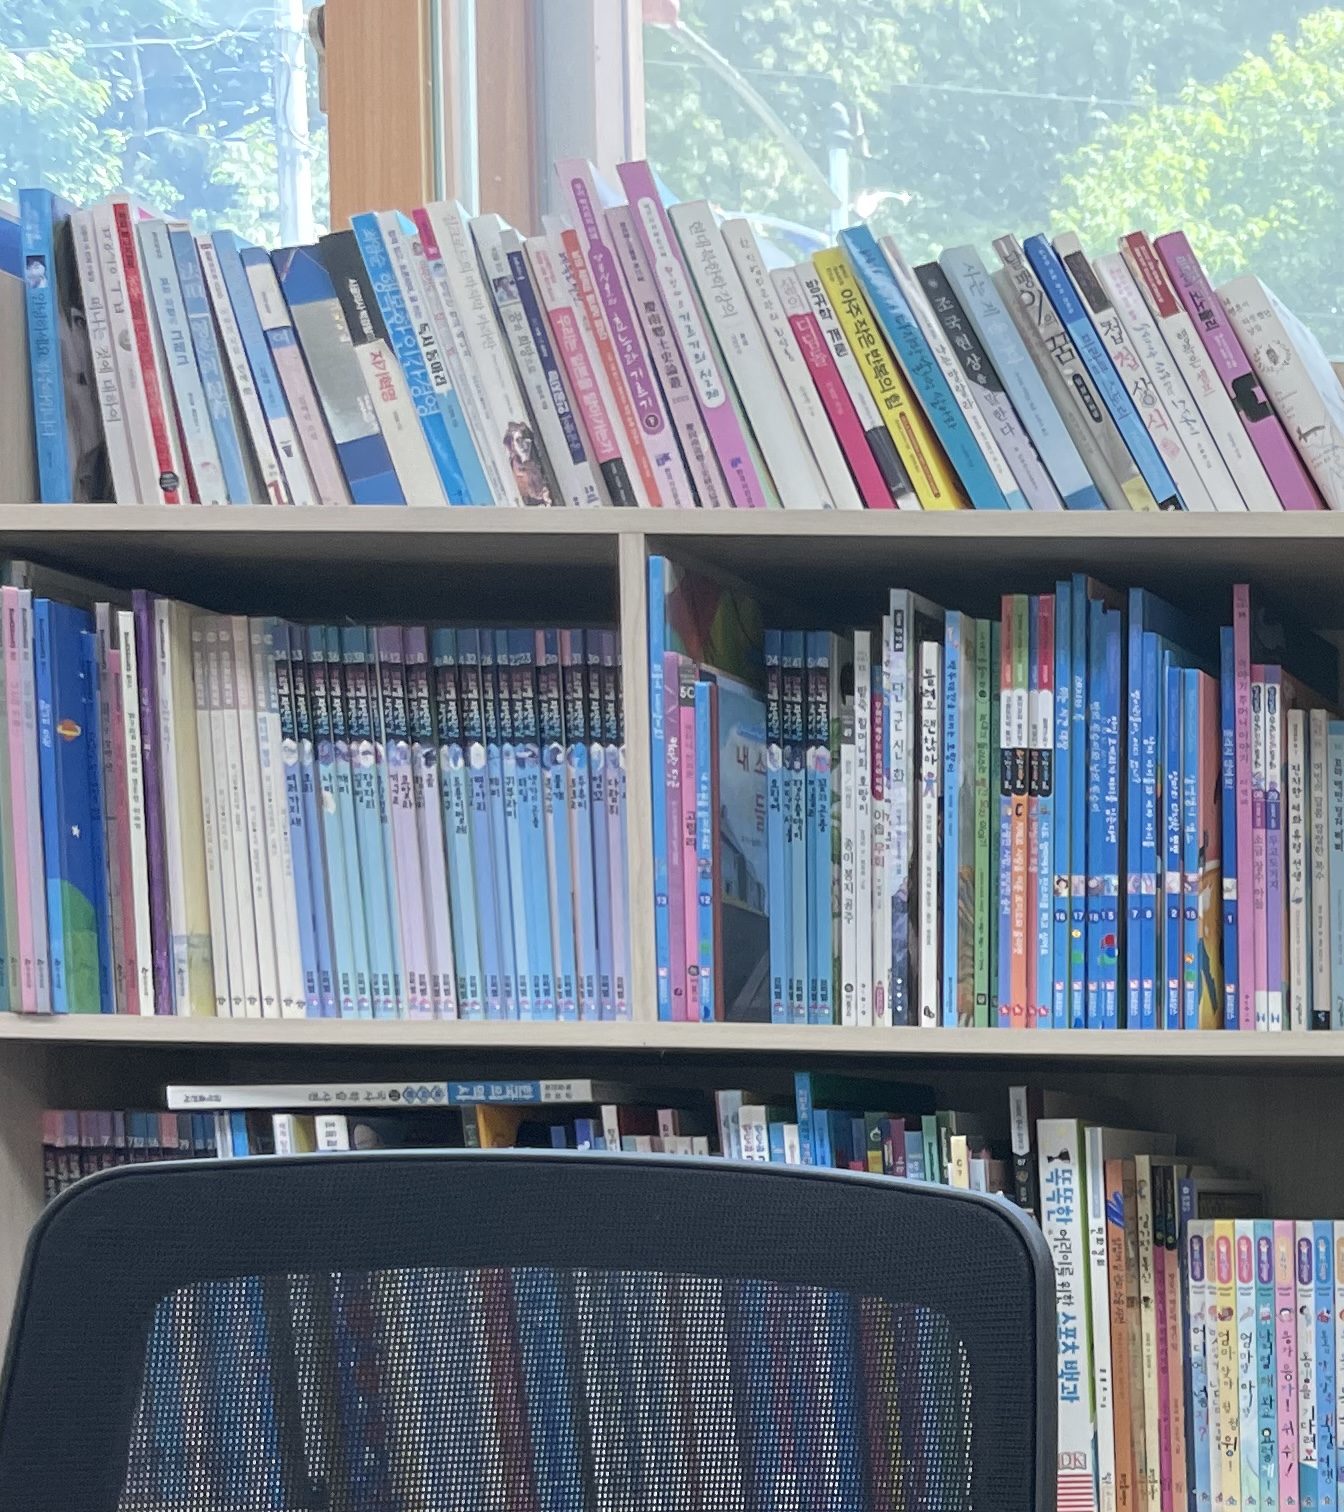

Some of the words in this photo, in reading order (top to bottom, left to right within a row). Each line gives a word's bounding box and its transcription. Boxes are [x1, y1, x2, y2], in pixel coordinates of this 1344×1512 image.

[419, 322, 435, 351] 독서
[841, 289, 861, 318] 아주
[855, 318, 875, 348] 작은
[865, 348, 895, 398] 반복의
[426, 350, 448, 388] 동아리
